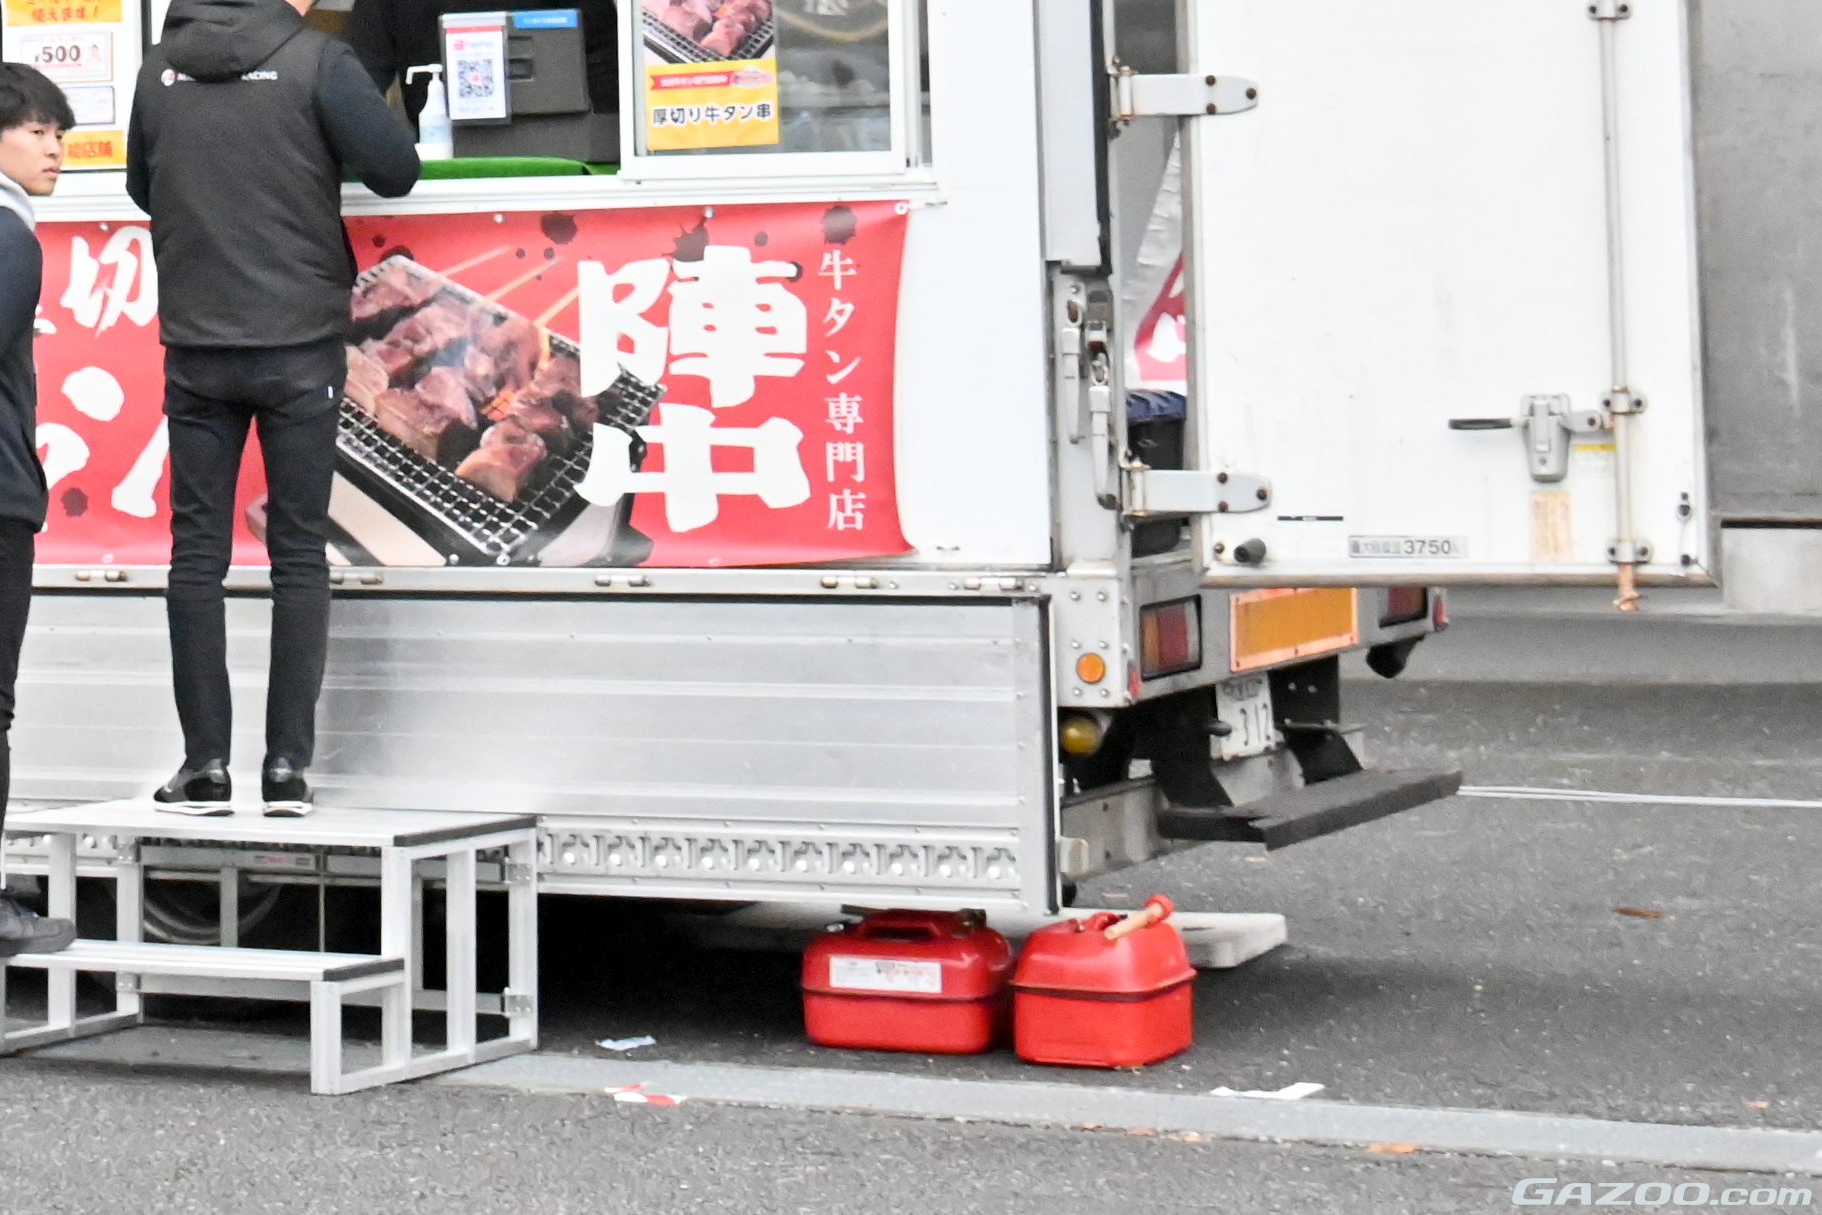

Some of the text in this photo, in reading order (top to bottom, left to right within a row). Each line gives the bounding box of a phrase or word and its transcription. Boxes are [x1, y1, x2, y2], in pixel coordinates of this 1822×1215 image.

[653, 103, 772, 125] 厚切り牛タン串
[574, 245, 811, 533] 陣中
[818, 250, 867, 532] 牛タン専門店
[1404, 539, 1452, 555] 3750
